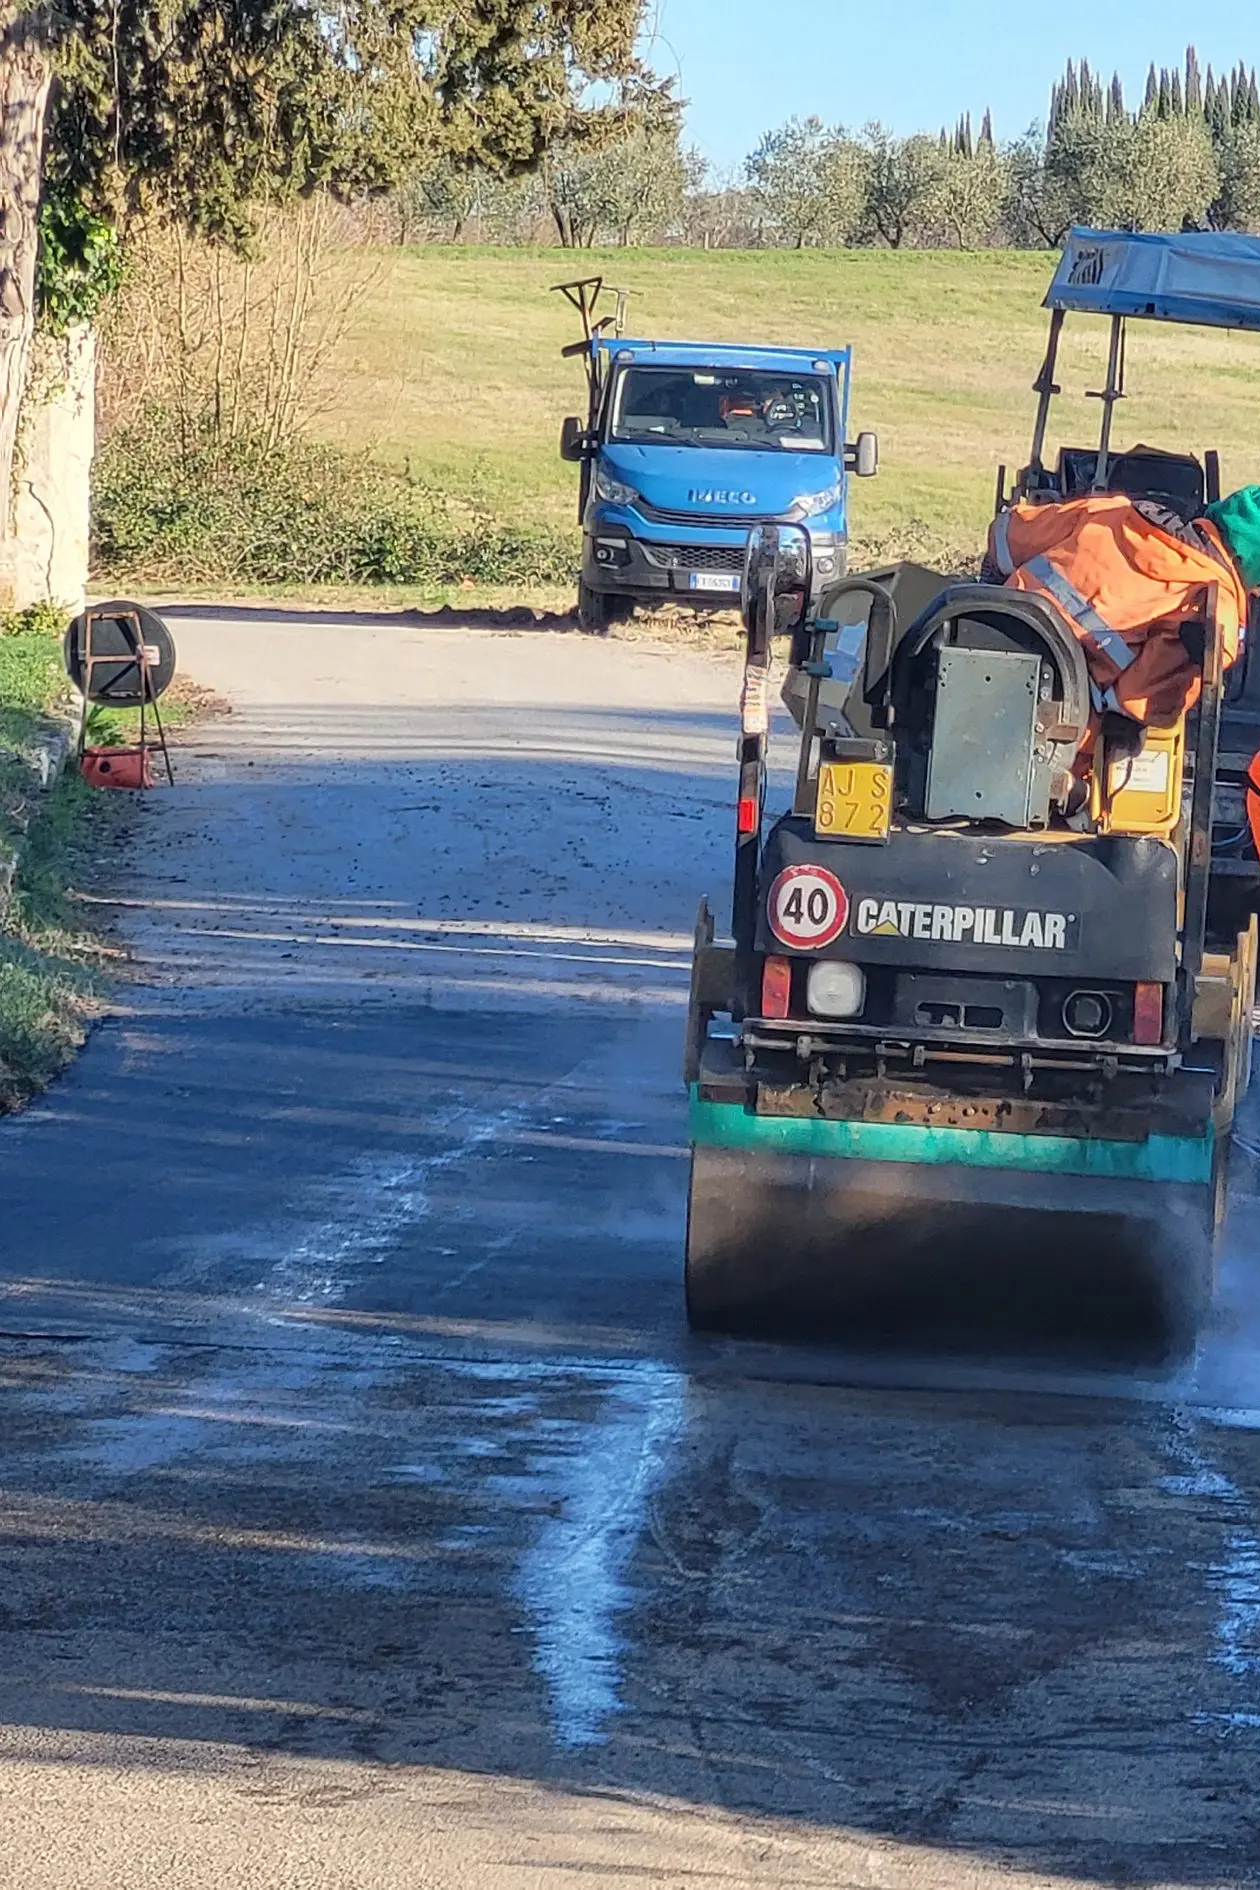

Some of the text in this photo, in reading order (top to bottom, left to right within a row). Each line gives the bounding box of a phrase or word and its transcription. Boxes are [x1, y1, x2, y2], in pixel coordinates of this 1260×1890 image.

[689, 489, 757, 504] IVECO
[820, 801, 884, 832] 872
[783, 887, 829, 925] 40
[857, 898, 1066, 949] CATERPILLAR
